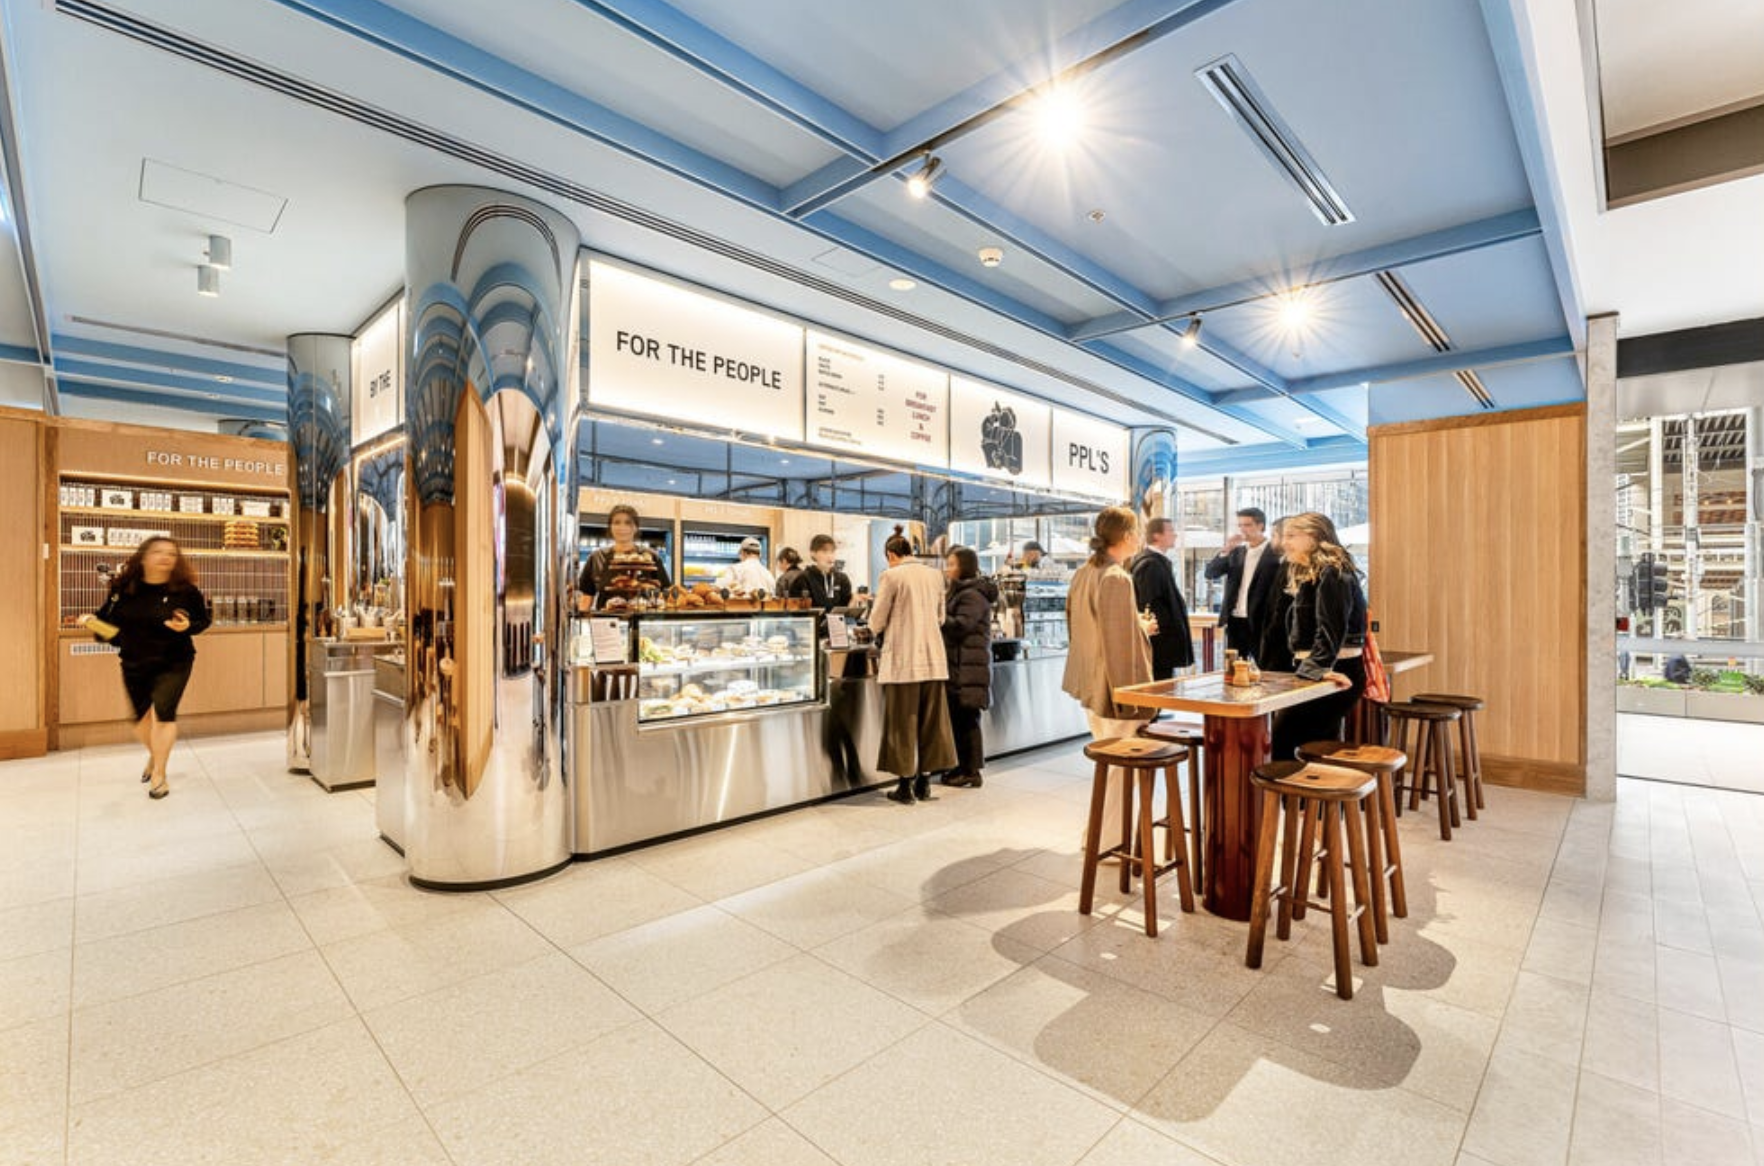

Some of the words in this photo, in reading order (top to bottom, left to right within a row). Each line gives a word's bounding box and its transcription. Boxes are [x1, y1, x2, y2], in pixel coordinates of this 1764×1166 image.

[616, 331, 660, 361] FOR
[667, 343, 706, 372] THE
[713, 356, 782, 390] PEOPLE
[146, 451, 182, 466] FOR
[187, 455, 219, 469] THE
[224, 458, 284, 476] PEOPLE
